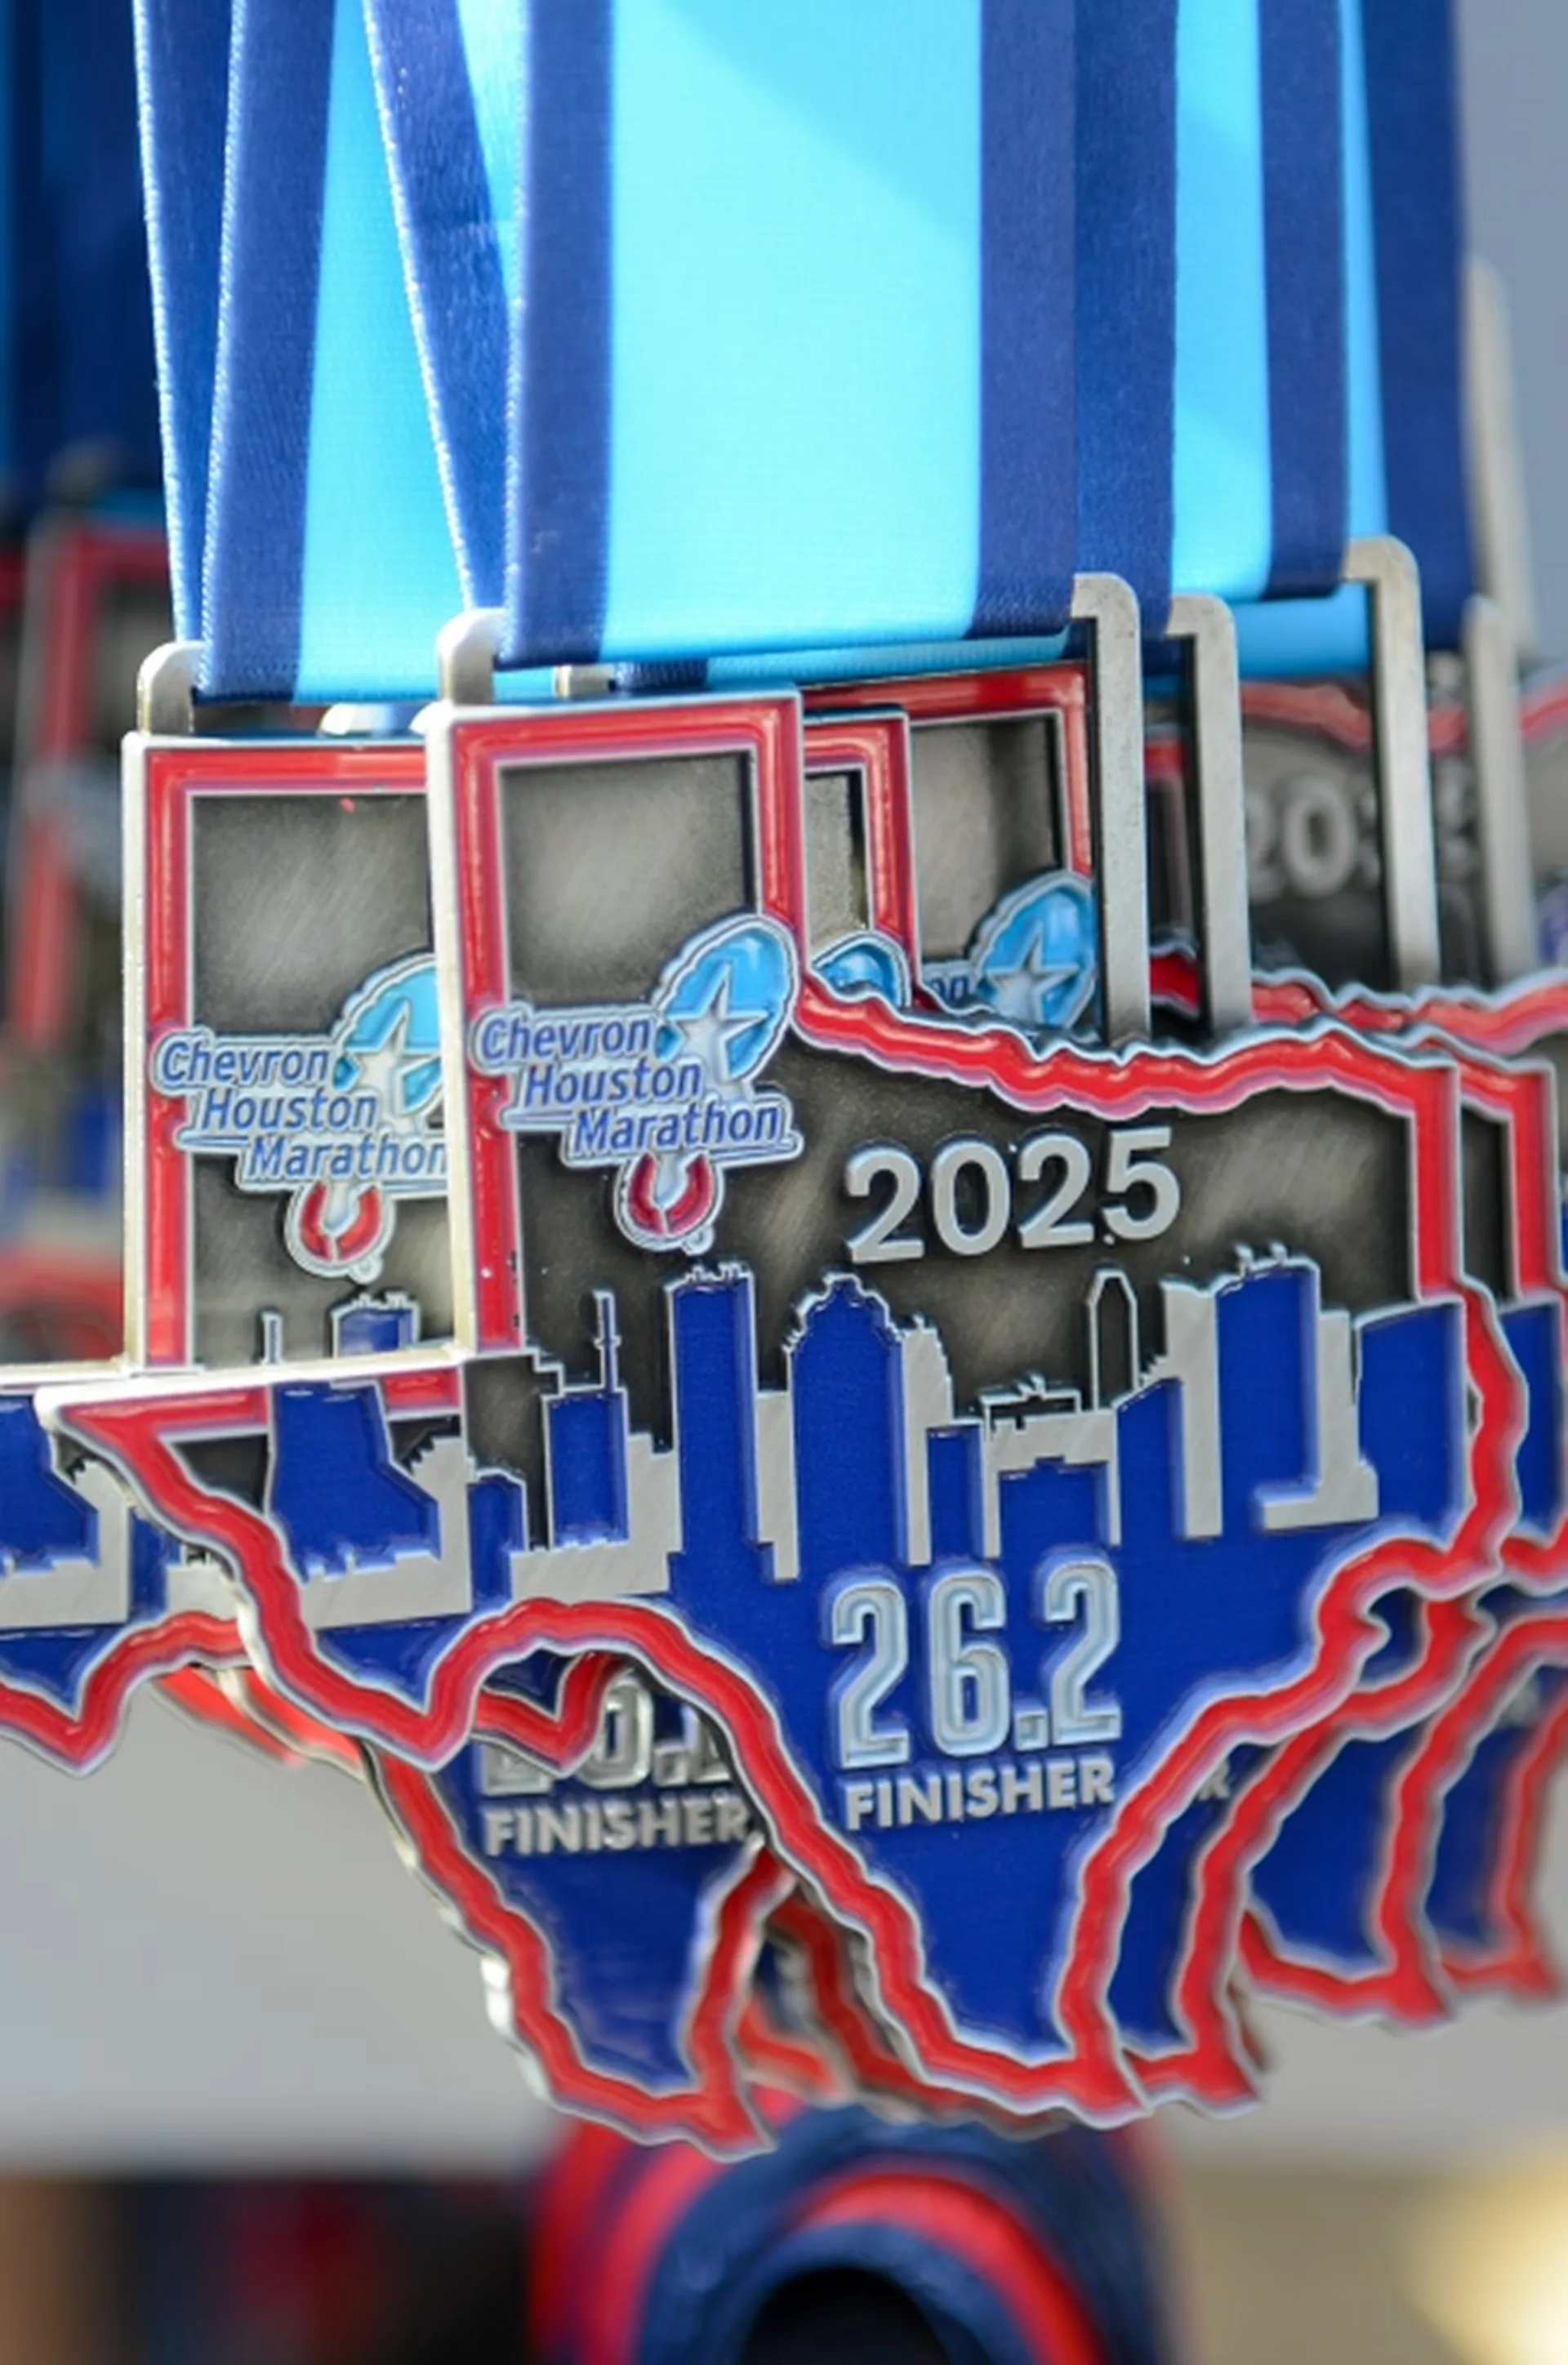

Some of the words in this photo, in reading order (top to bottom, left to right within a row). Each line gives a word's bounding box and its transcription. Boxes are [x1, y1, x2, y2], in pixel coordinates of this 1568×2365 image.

[163, 1039, 330, 1083] Chevron
[481, 1016, 651, 1061] Chevron
[523, 1061, 702, 1107] Houston
[201, 1089, 378, 1130] Houston
[574, 1103, 781, 1152] Marathon
[248, 1134, 448, 1177] Marathon
[845, 1127, 1180, 1264] 2025
[831, 1559, 1122, 1769] 26.2
[844, 1757, 1114, 1830] FINISHER
[483, 1797, 750, 1856] FINISHER
